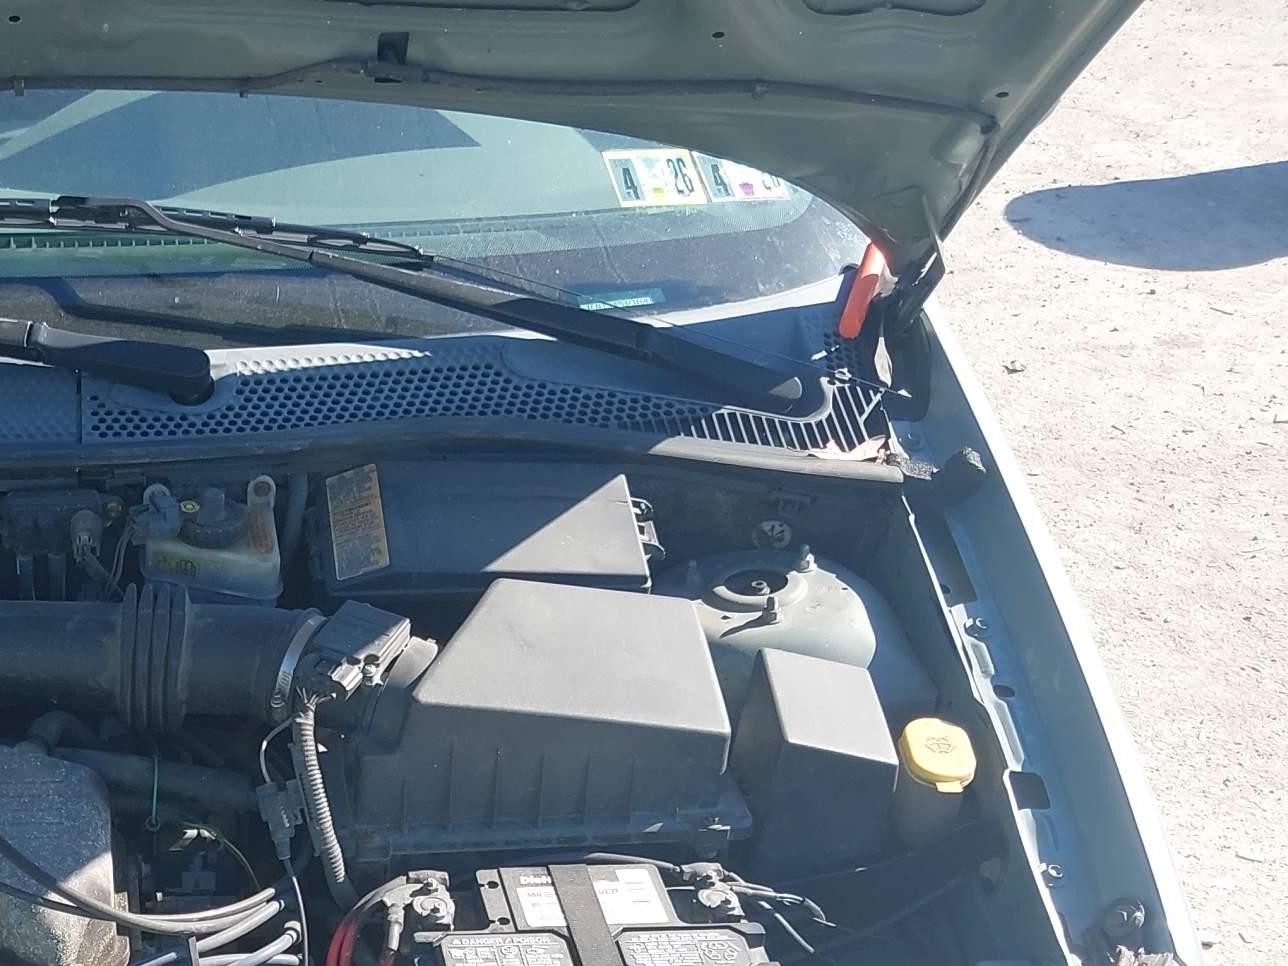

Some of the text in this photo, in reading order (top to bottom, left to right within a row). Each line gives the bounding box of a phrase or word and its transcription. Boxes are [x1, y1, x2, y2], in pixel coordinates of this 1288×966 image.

[621, 157, 695, 200] 4 26
[711, 164, 731, 197] 4
[519, 875, 552, 885] DieH
